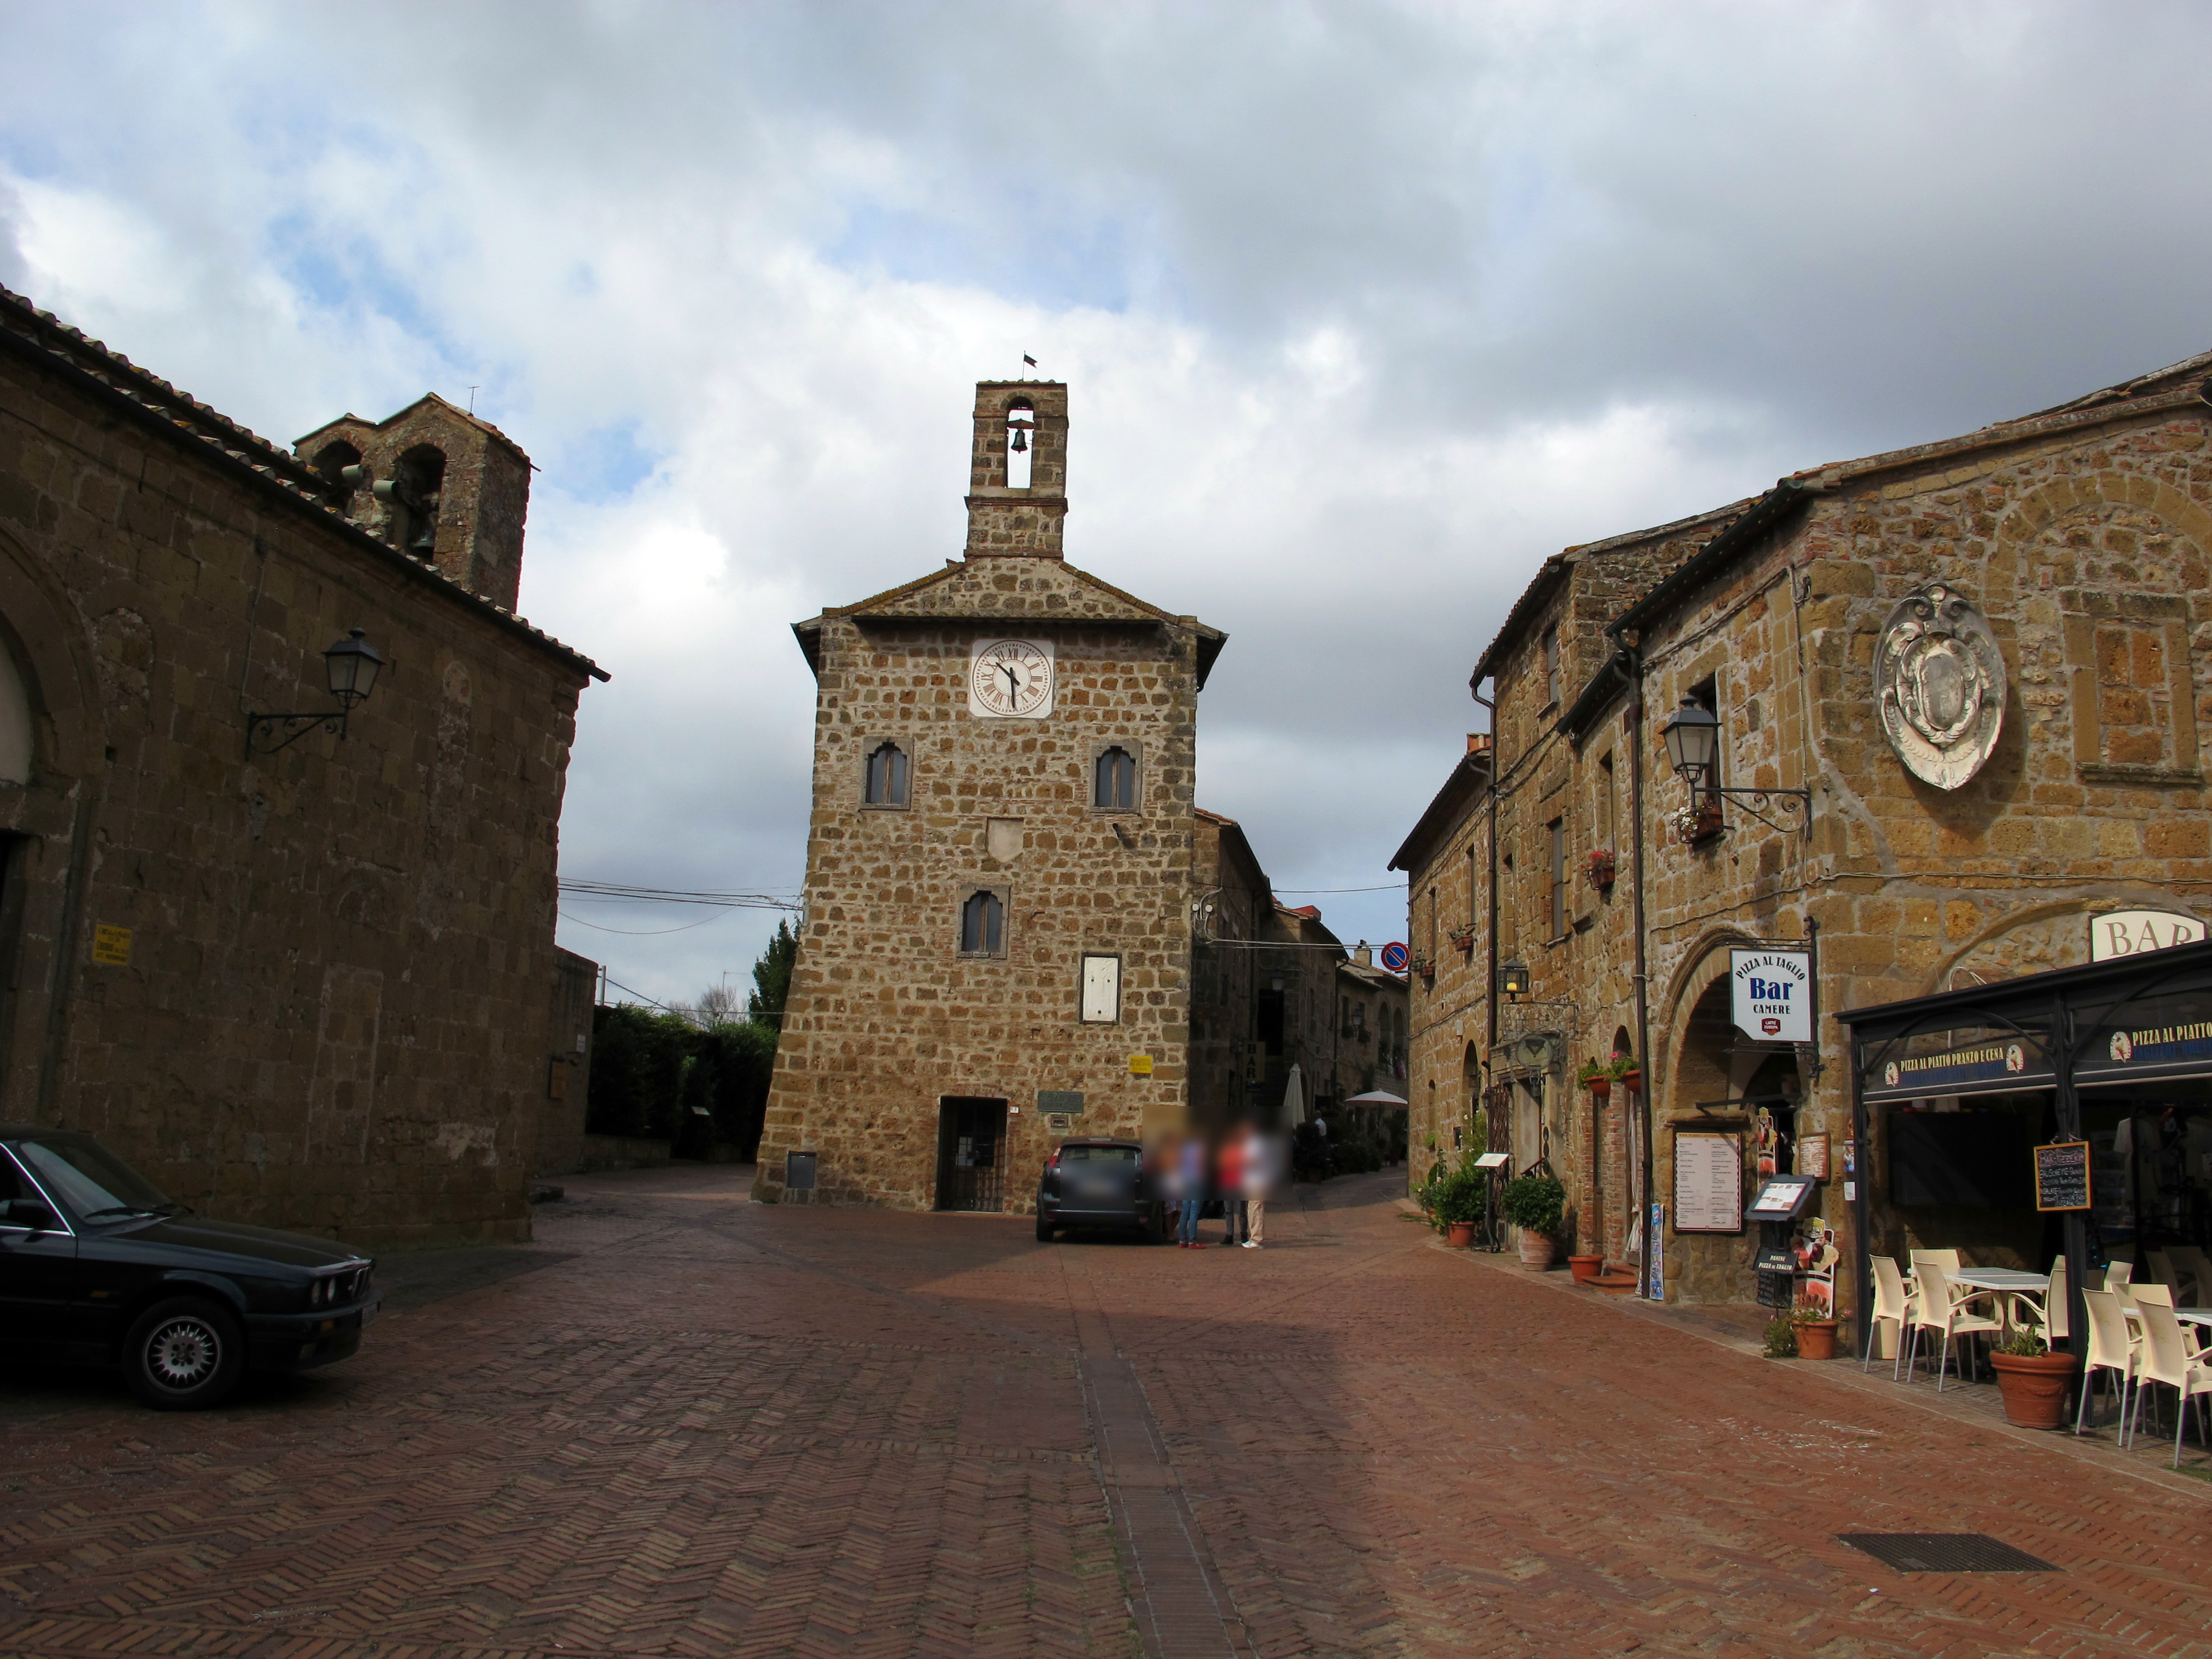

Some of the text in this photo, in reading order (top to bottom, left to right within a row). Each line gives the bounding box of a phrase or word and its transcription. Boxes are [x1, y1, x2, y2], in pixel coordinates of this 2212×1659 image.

[2105, 919, 2193, 956] BAR
[1735, 956, 1805, 980] PIZZA AL TAGLIO
[1749, 977, 1793, 1000] Bar
[1753, 1004, 1791, 1014] CAMERE
[2132, 1029, 2161, 1047] PIZZA
[2162, 1027, 2175, 1043] AL
[2176, 1021, 2212, 1041] PIATTO
[1247, 1044, 1256, 1078] BAR
[1900, 1047, 2004, 1072] PIZZA AL PIATTO PRANZO E CENA
